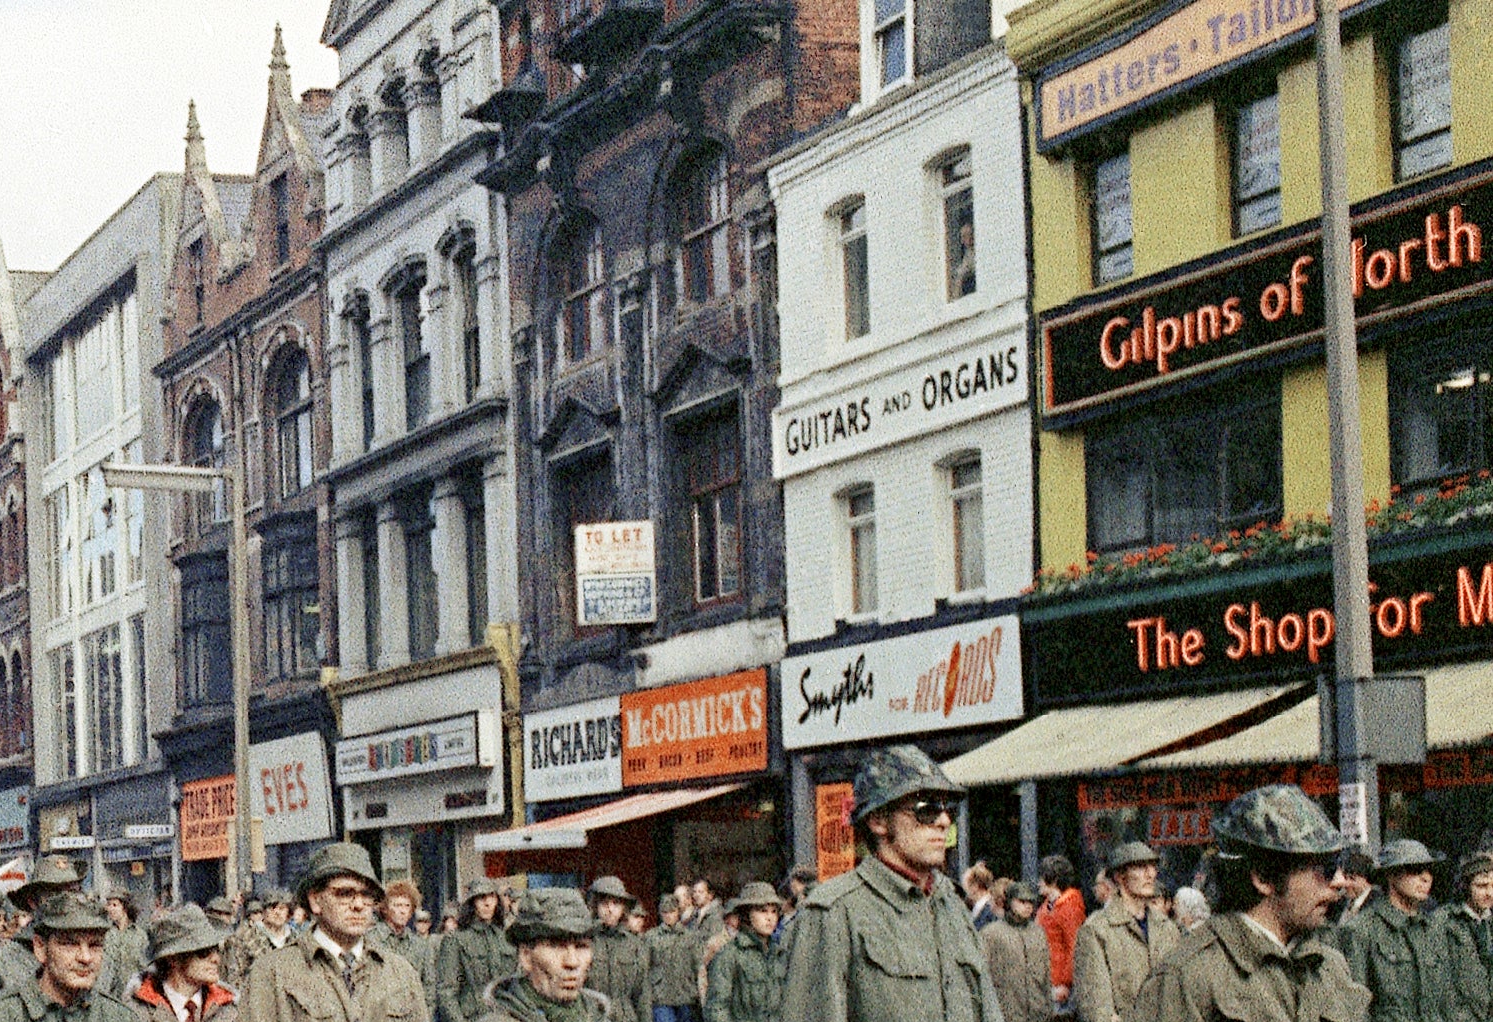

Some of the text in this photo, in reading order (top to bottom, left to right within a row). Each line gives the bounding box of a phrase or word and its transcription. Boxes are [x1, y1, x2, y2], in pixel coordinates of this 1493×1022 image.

[1056, 38, 1183, 123] Hatters
[1099, 296, 1244, 374] Gilpins
[1259, 255, 1315, 323] of
[785, 346, 1019, 456] GUITARS AND ORGANS
[585, 527, 642, 545] TO LET
[914, 626, 1003, 718] RECORDS
[1127, 616, 1207, 673] The
[1224, 601, 1336, 664] Shop
[1368, 581, 1435, 637] or
